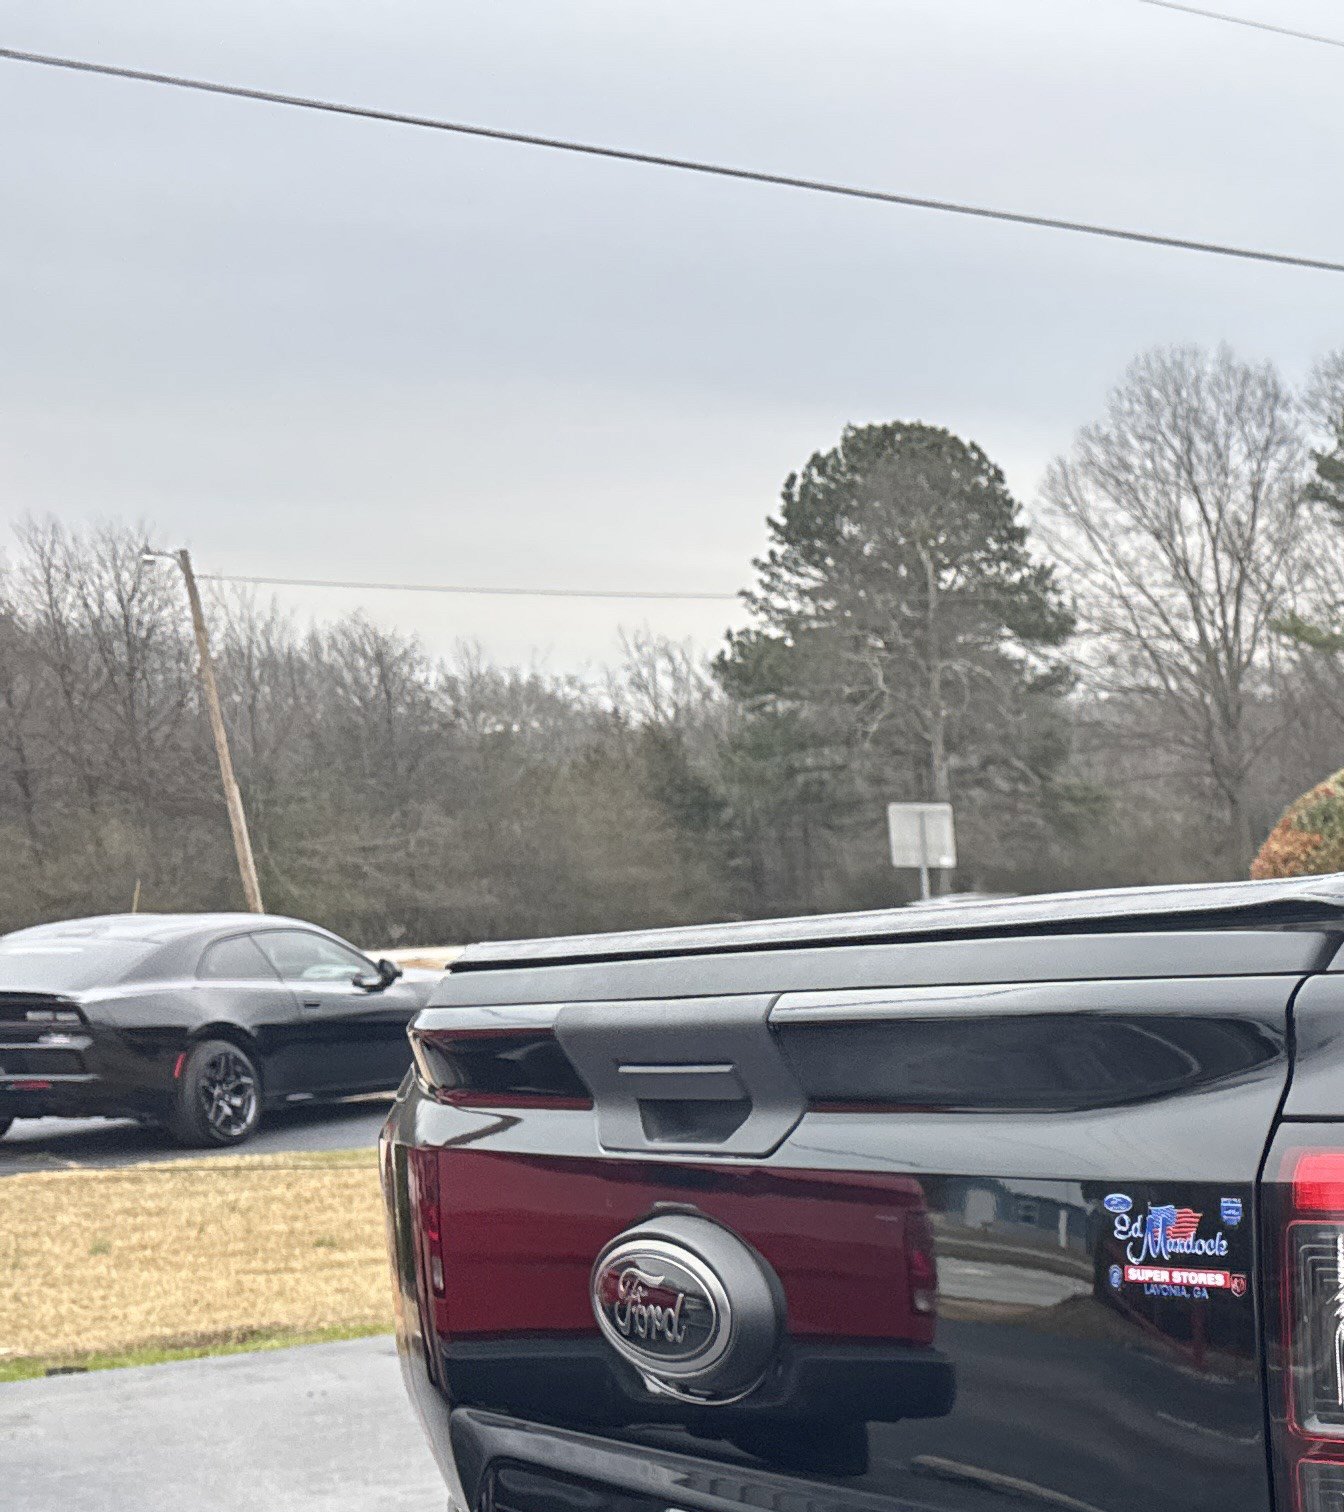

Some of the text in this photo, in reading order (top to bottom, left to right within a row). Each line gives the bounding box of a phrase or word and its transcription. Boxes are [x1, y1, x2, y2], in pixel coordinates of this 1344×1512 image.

[1113, 1213, 1144, 1241] Ed
[1127, 1268, 1225, 1287] SUPER STORES
[614, 1267, 687, 1343] Ford
